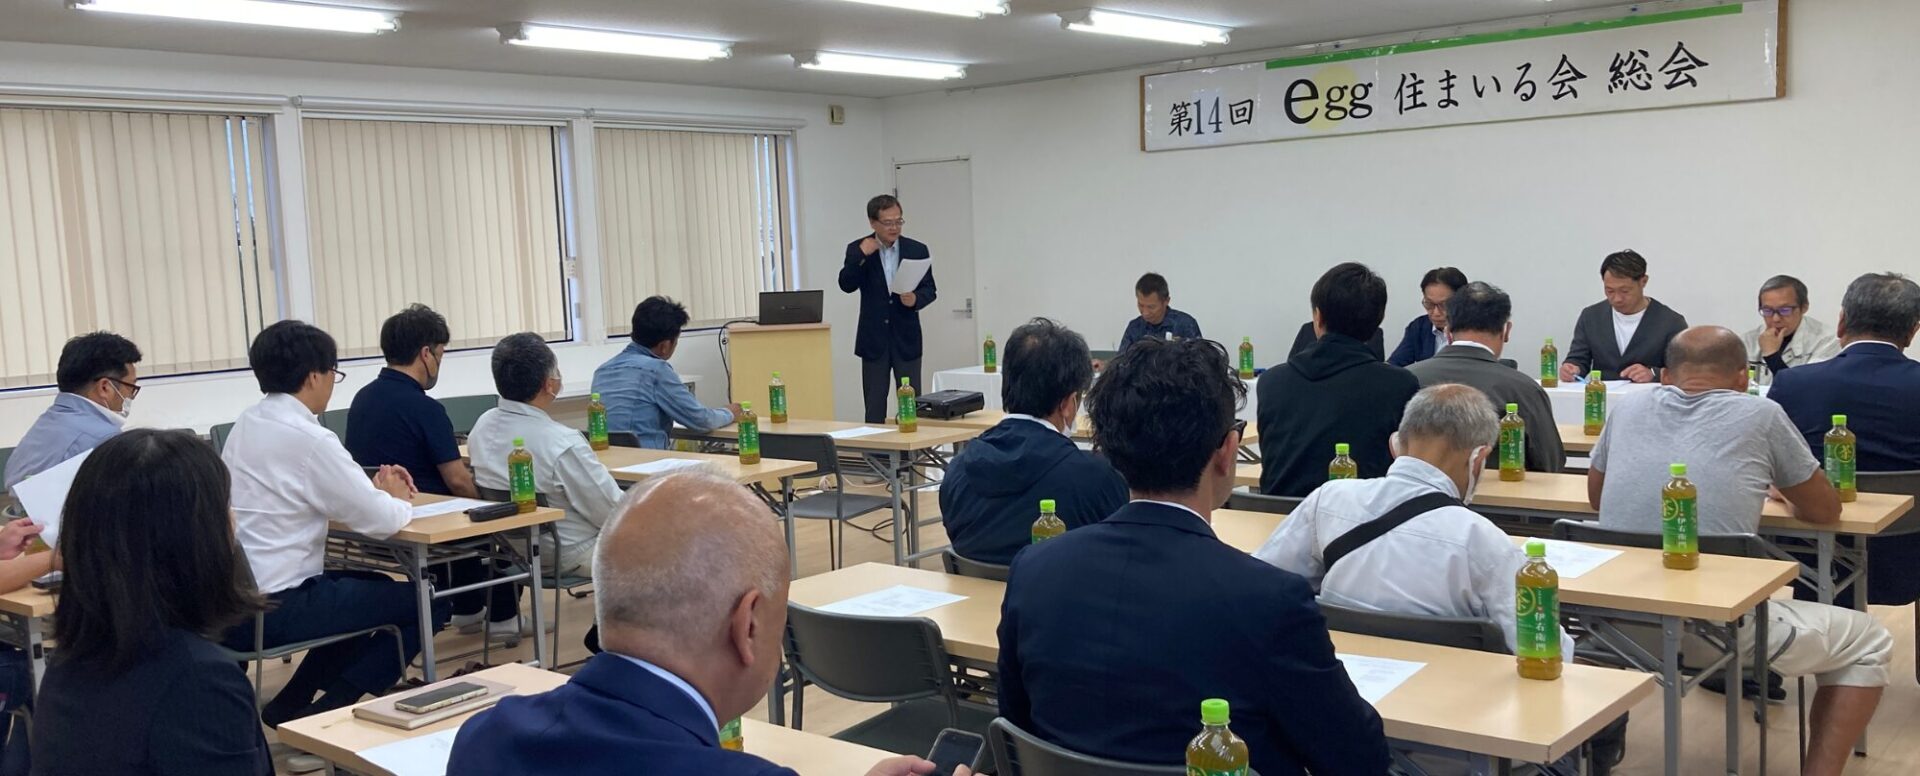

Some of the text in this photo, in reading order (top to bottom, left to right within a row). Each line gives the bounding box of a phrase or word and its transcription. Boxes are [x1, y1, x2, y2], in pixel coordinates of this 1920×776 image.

[1168, 40, 1710, 137] 第14回 egg 住まいる会 総会
